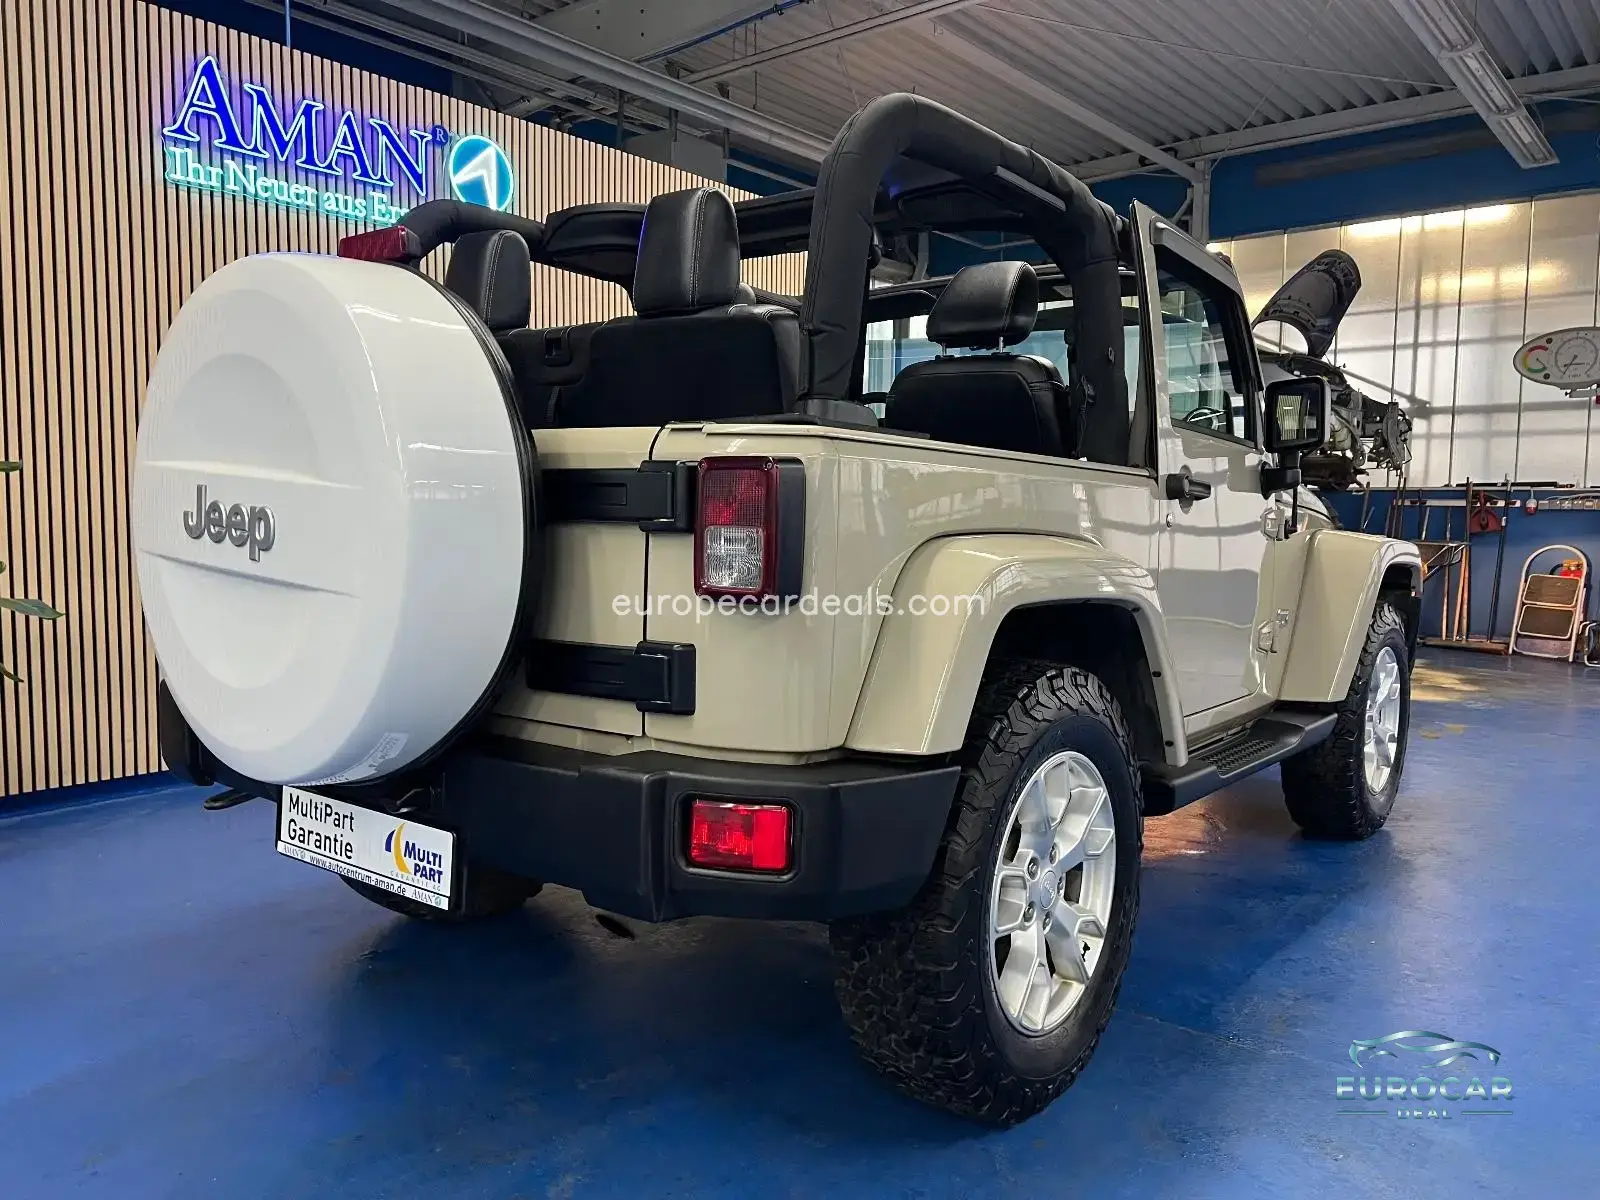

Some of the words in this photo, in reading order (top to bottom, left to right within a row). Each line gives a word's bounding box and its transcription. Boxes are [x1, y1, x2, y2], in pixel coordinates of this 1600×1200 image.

[168, 146, 223, 188] Ihr
[223, 159, 318, 207] Neuer
[323, 191, 367, 218] aus
[183, 484, 275, 562] Jeep
[289, 792, 355, 832] MultiPart
[287, 818, 353, 860] Garantie
[403, 840, 442, 869] MULTI
[309, 855, 407, 896] www.autocentrum-aman.de
[413, 862, 443, 884] PART
